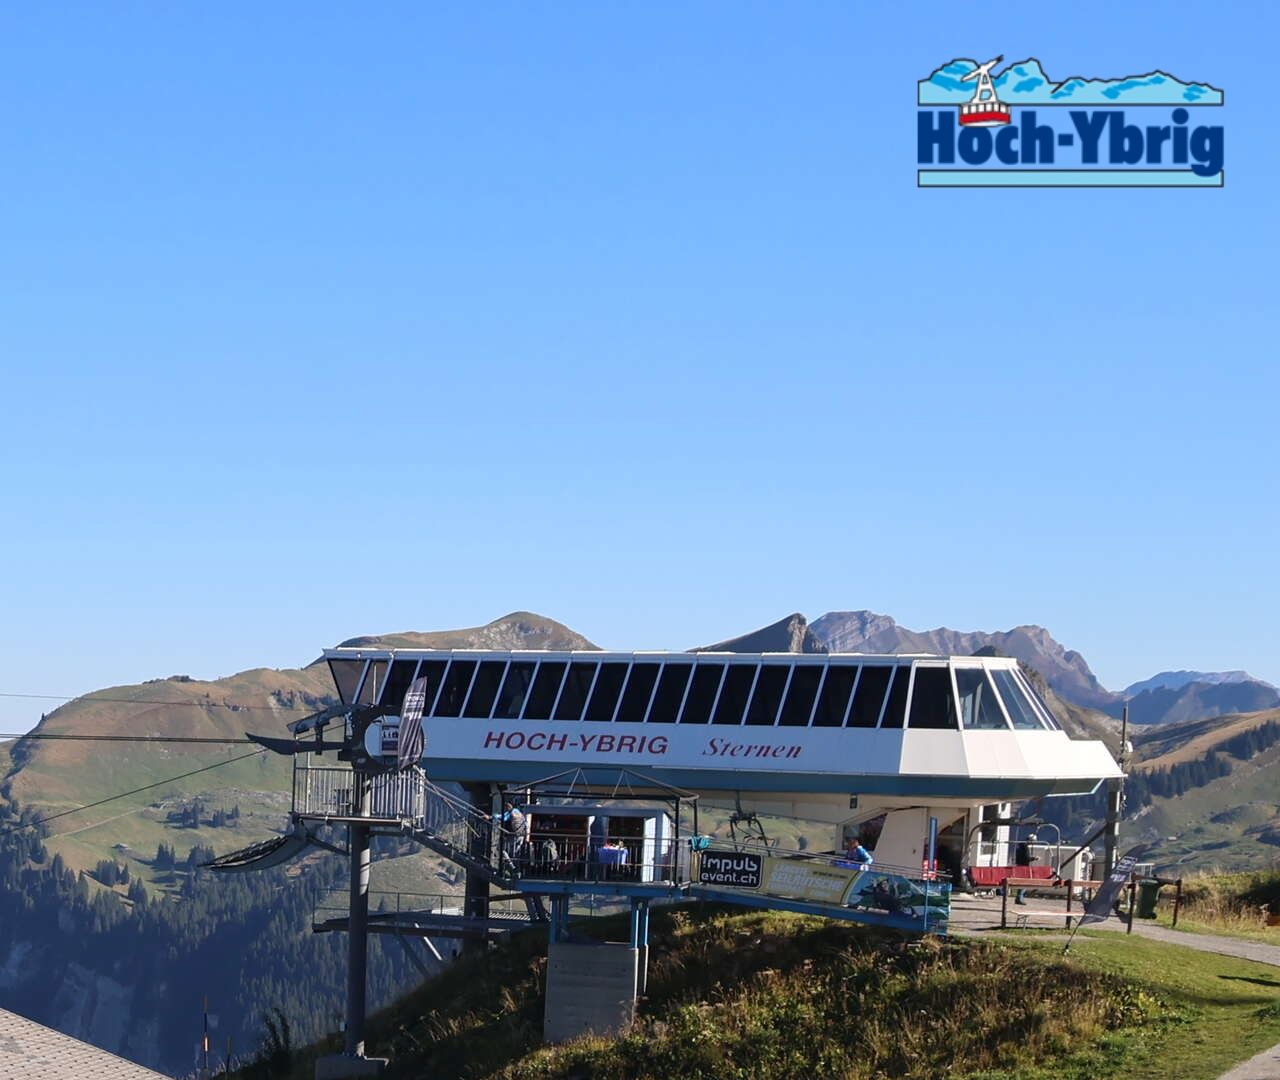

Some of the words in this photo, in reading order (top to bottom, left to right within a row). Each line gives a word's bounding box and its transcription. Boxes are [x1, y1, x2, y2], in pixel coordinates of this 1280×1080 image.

[483, 731, 669, 755] HOCH-YBRIG
[702, 737, 803, 758] Sternen
[701, 872, 757, 884] event.ch
